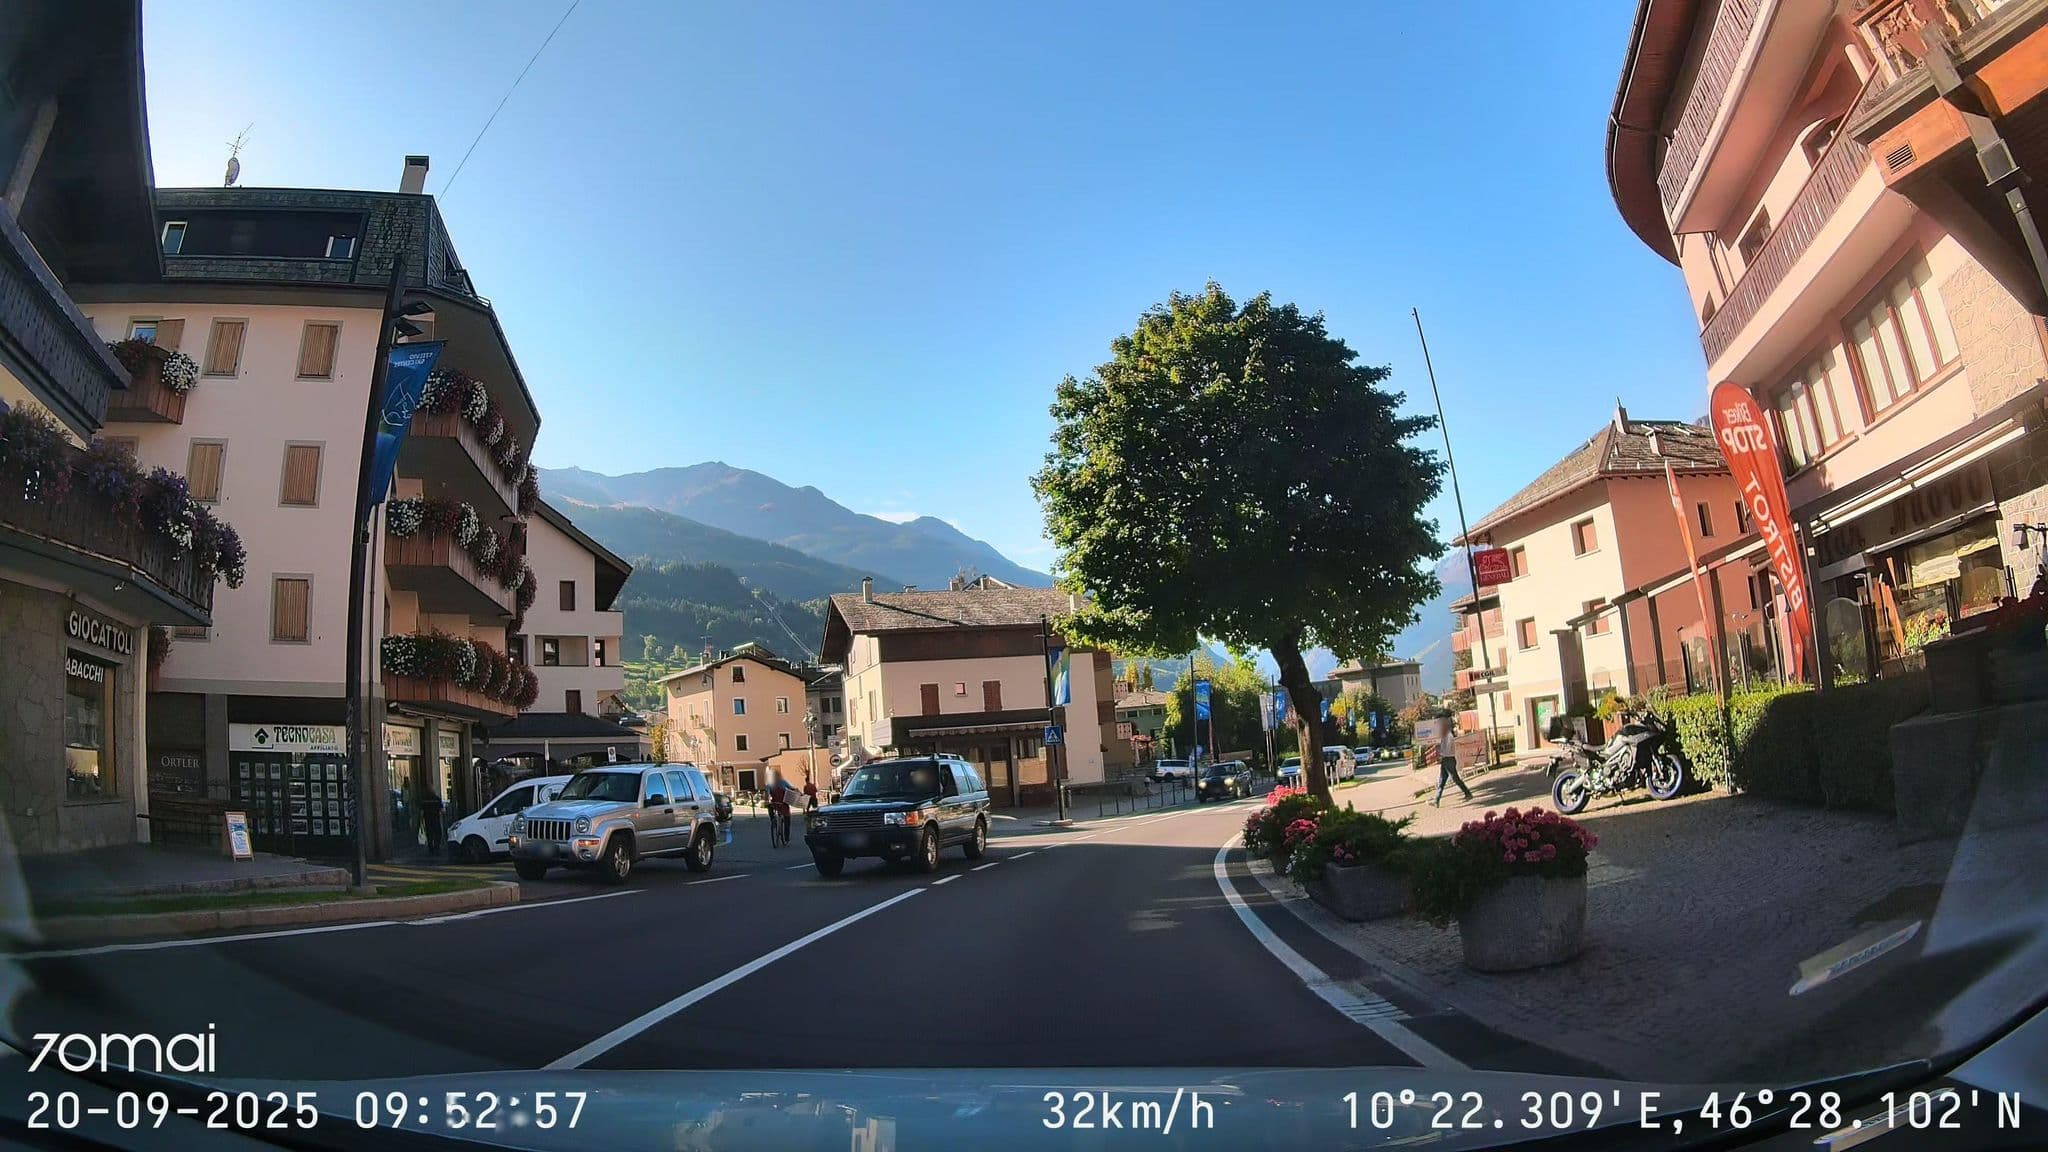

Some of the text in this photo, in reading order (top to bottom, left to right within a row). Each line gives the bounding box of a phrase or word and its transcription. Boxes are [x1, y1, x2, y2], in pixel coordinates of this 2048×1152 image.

[69, 610, 133, 655] GIOCATTOLI
[273, 726, 336, 744] TECNOCASA
[160, 755, 200, 769] ORTLER
